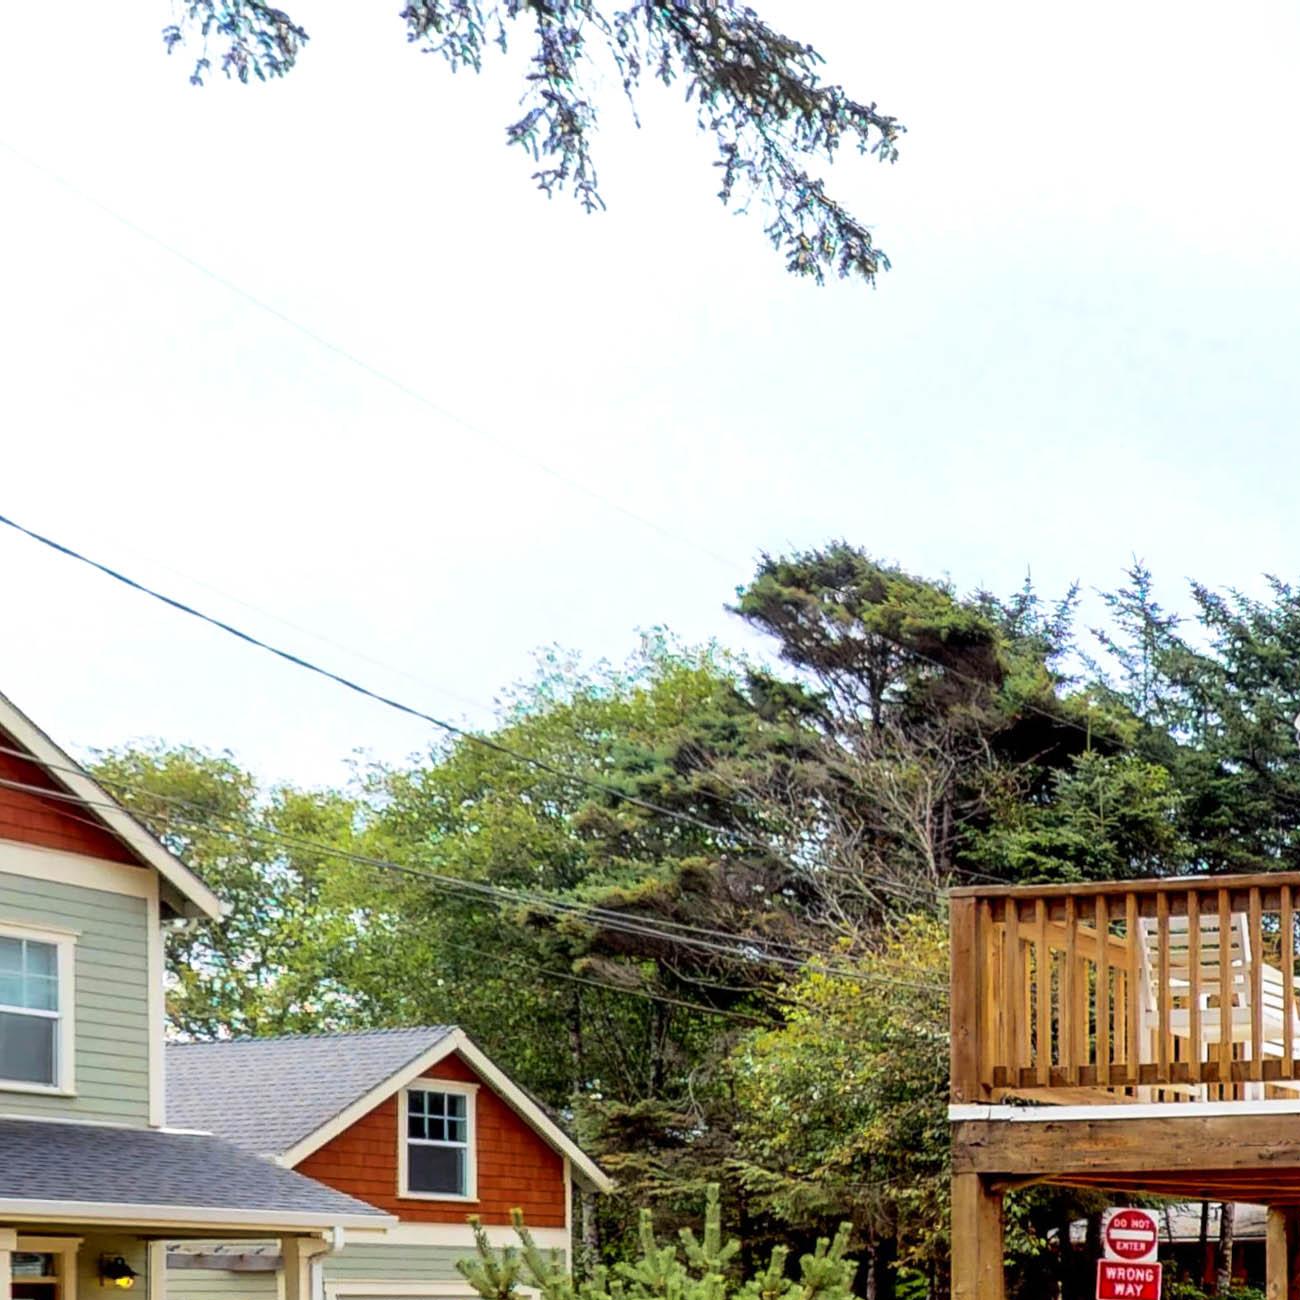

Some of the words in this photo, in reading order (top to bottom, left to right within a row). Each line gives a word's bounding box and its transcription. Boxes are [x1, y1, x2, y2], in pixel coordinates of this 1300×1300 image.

[1114, 1219, 1127, 1228] DO
[1131, 1219, 1150, 1229] NOT
[1116, 1241, 1146, 1251] ENTER
[1106, 1267, 1154, 1282] WRONG
[1114, 1283, 1143, 1296] WAY
